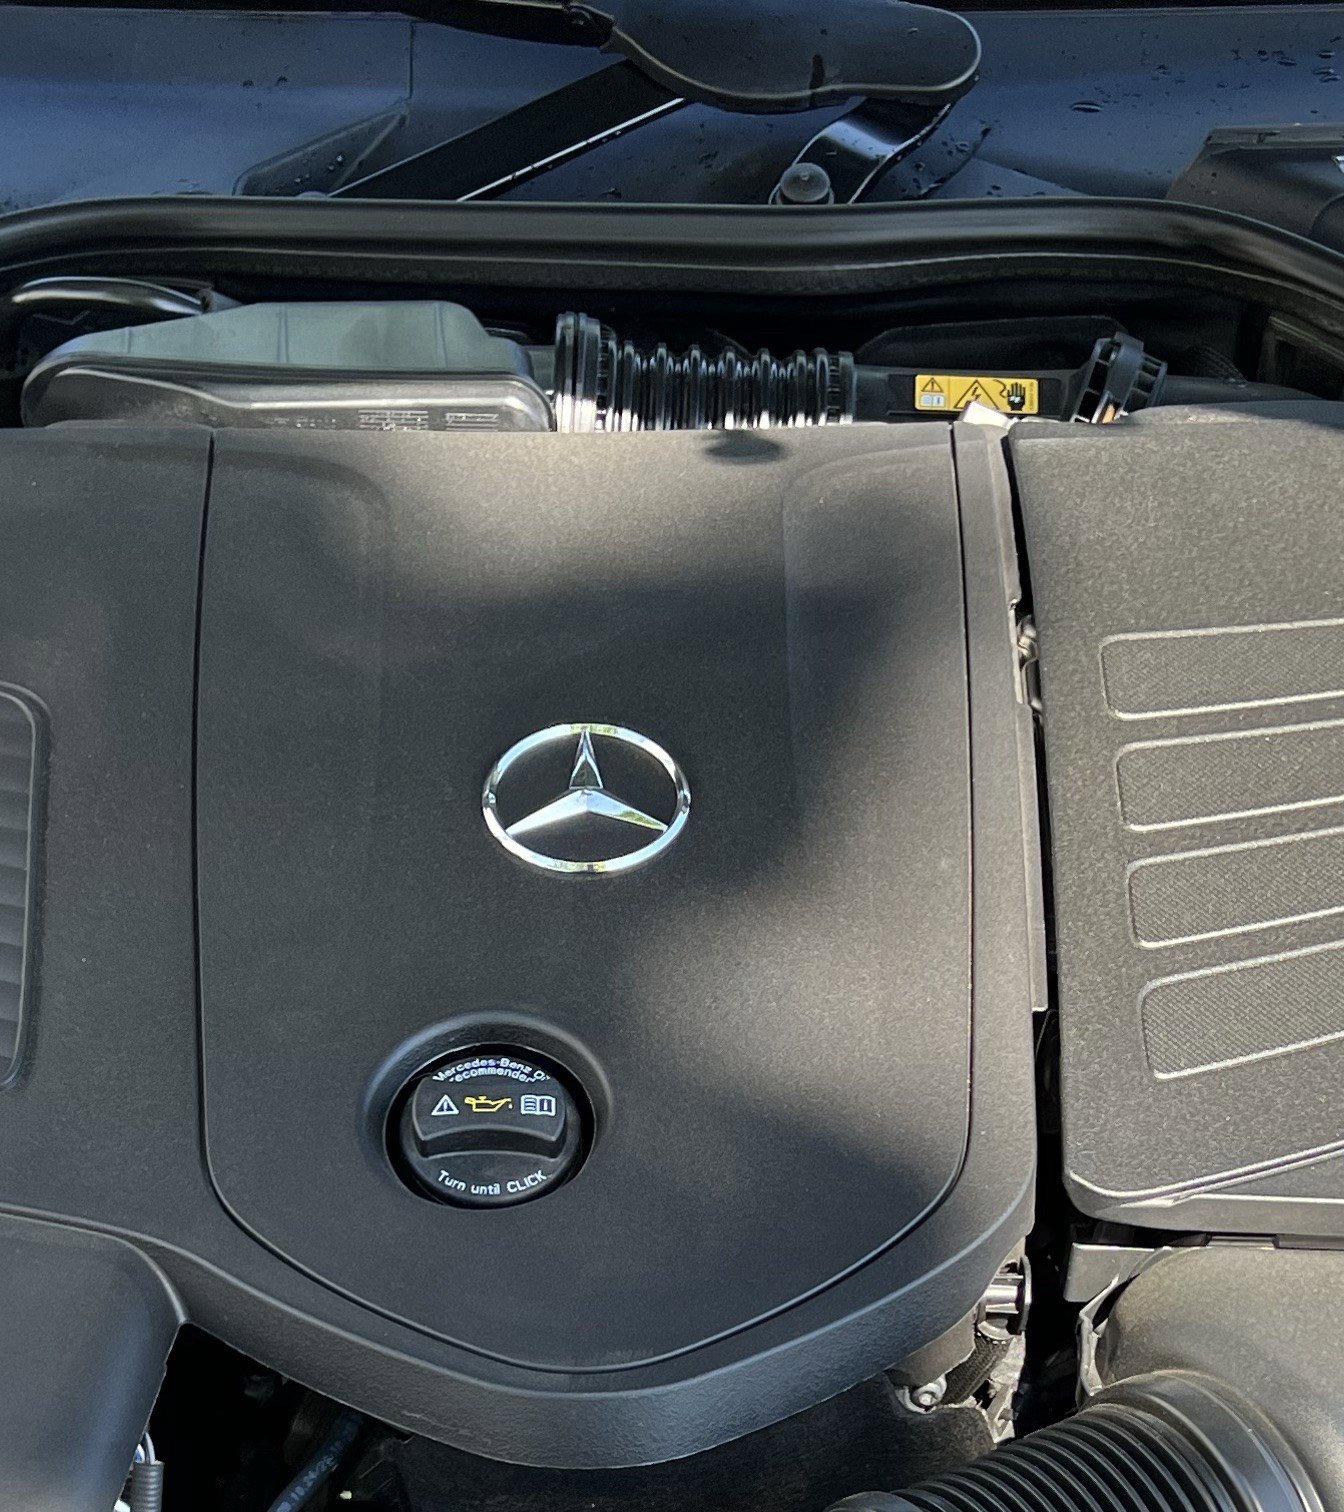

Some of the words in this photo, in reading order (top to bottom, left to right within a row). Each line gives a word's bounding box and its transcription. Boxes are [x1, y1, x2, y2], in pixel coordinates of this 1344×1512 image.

[431, 1057, 533, 1081] Mercedes-Benz
[436, 1170, 467, 1191] Turn
[471, 1182, 501, 1195] until
[506, 1170, 547, 1194] CLICK
